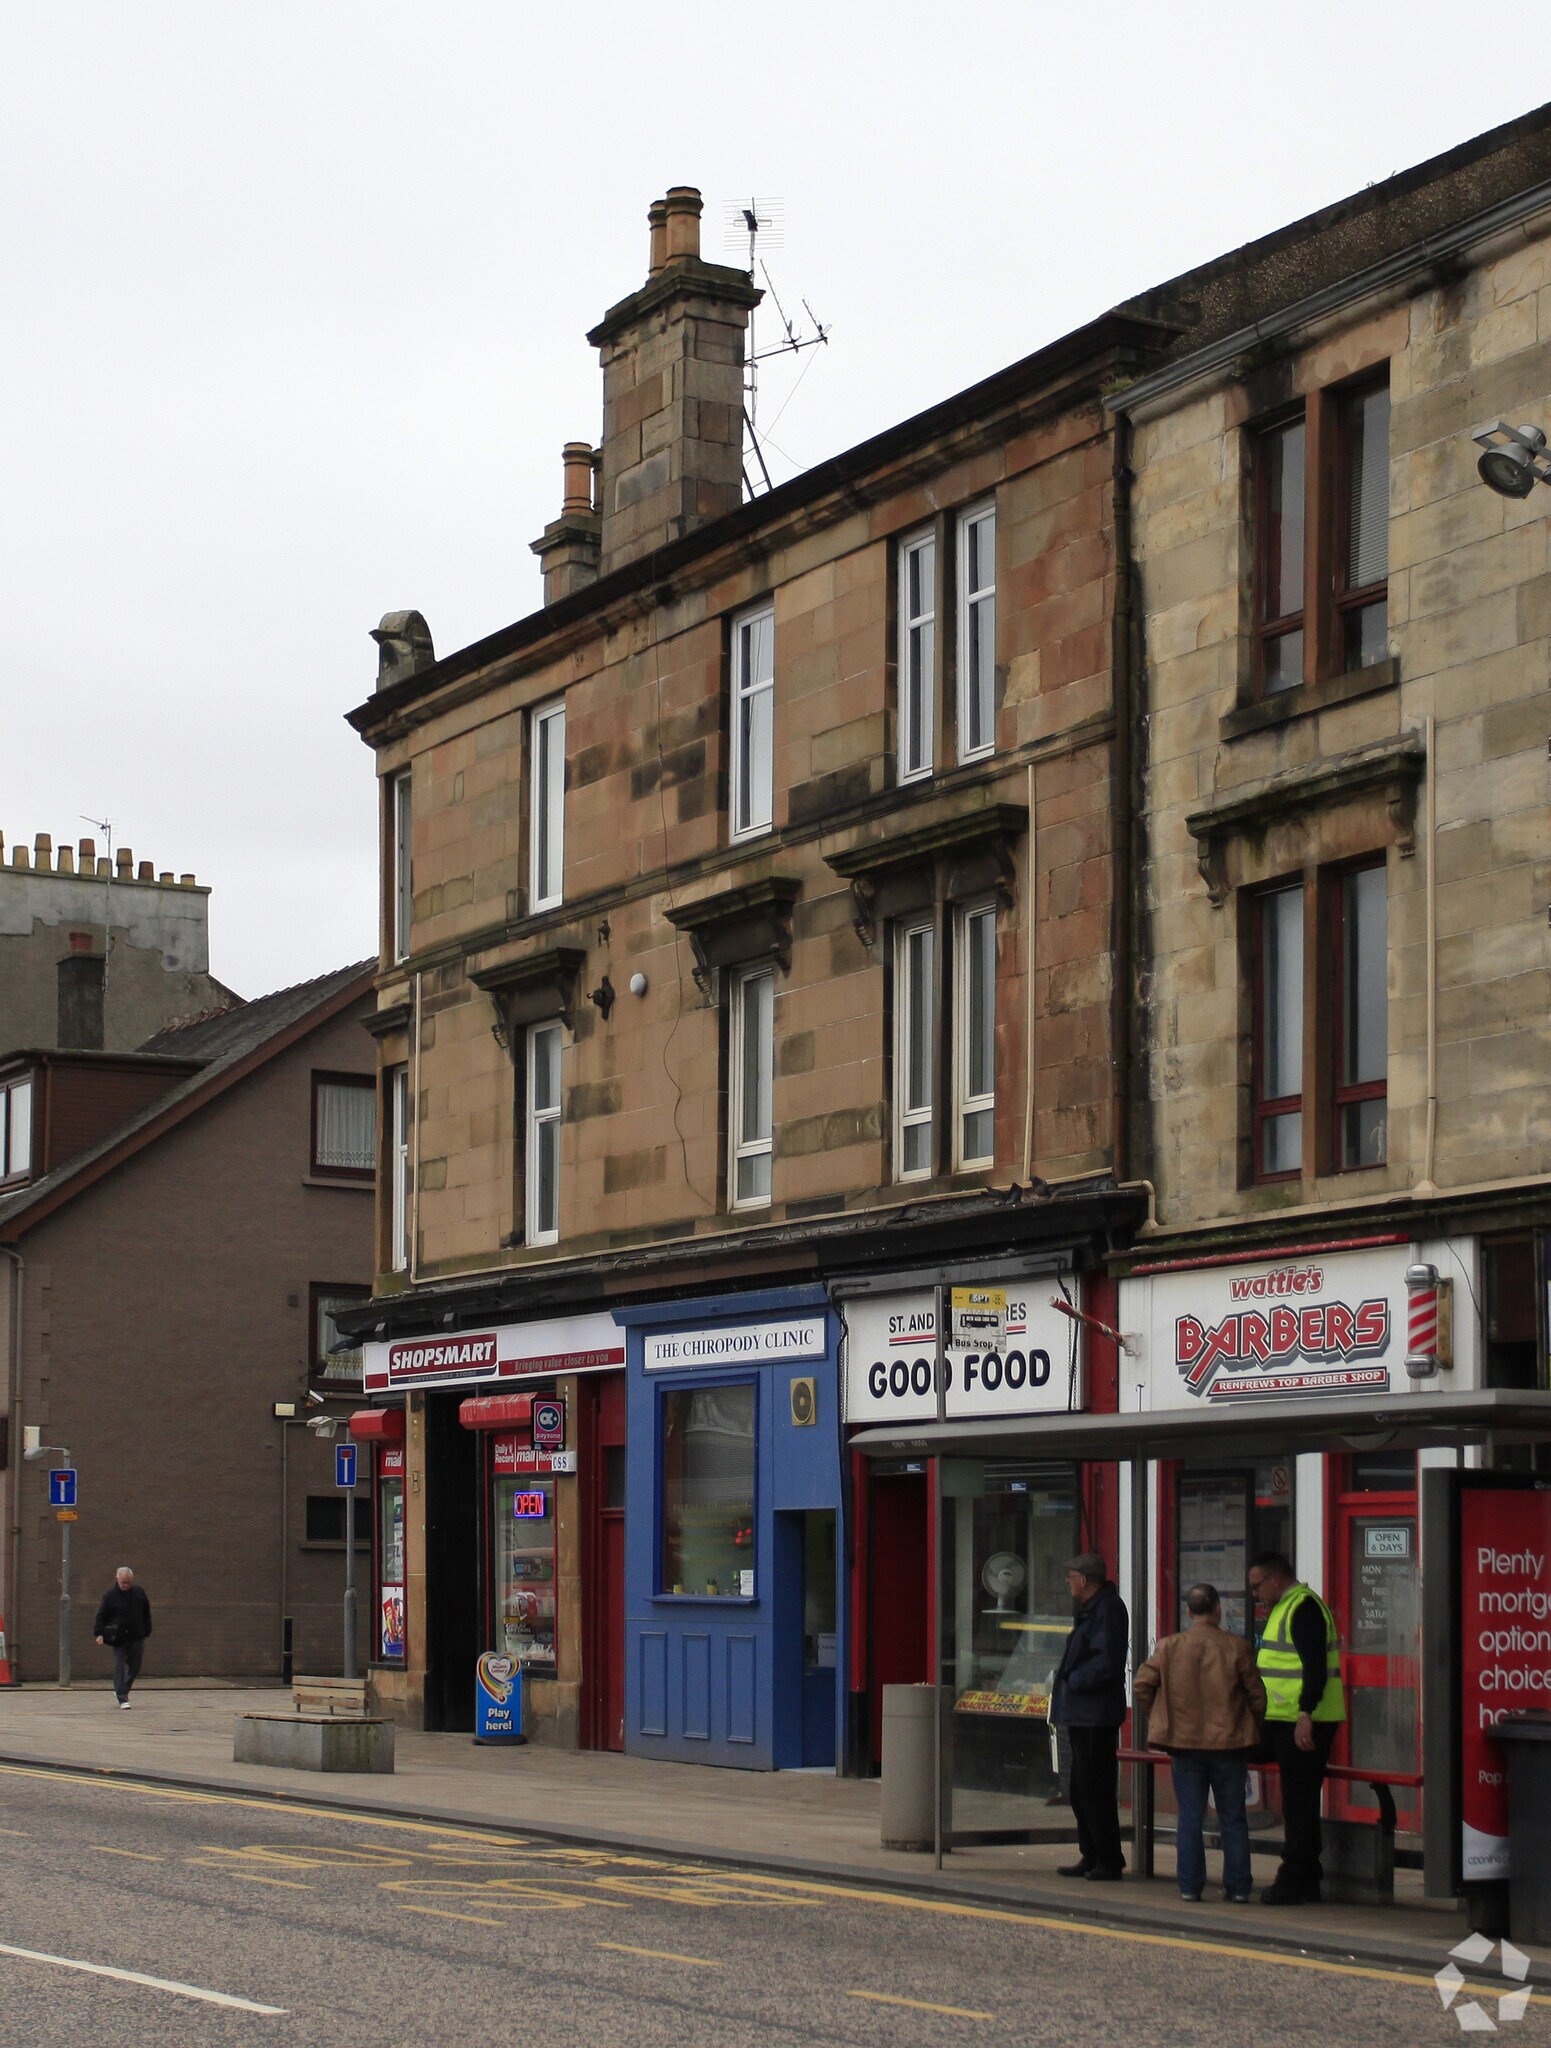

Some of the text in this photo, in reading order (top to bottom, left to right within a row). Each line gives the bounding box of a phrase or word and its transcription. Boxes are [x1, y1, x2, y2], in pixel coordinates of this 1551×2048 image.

[1230, 1266, 1323, 1300] wattie's
[889, 1315, 905, 1333] ST.
[654, 1329, 814, 1359] THE CHIROPODY CLINIC
[955, 1338, 993, 1349] Bus Stop
[1177, 1299, 1389, 1387] BARBERS
[391, 1341, 495, 1370] SHOPSMART
[514, 1353, 609, 1373] Bringing value closer to you
[407, 1373, 453, 1383] CONVENIENCE
[963, 1349, 1051, 1393] FOOD
[1219, 1371, 1381, 1390] RENFREWS TOP BARBER SHOP
[494, 1444, 508, 1455] Daily
[494, 1453, 514, 1463] Record
[516, 1450, 536, 1462] mail
[385, 1450, 403, 1467] mail
[516, 1495, 542, 1515] OPEN
[1375, 1533, 1401, 1542] OPEN
[1371, 1543, 1404, 1552] 6 DAYS
[1361, 1565, 1382, 1575] MON
[1477, 1547, 1545, 1581] Plenty
[488, 1707, 511, 1720] Play
[486, 1720, 513, 1731] here!
[1478, 1769, 1502, 1786] Pop
